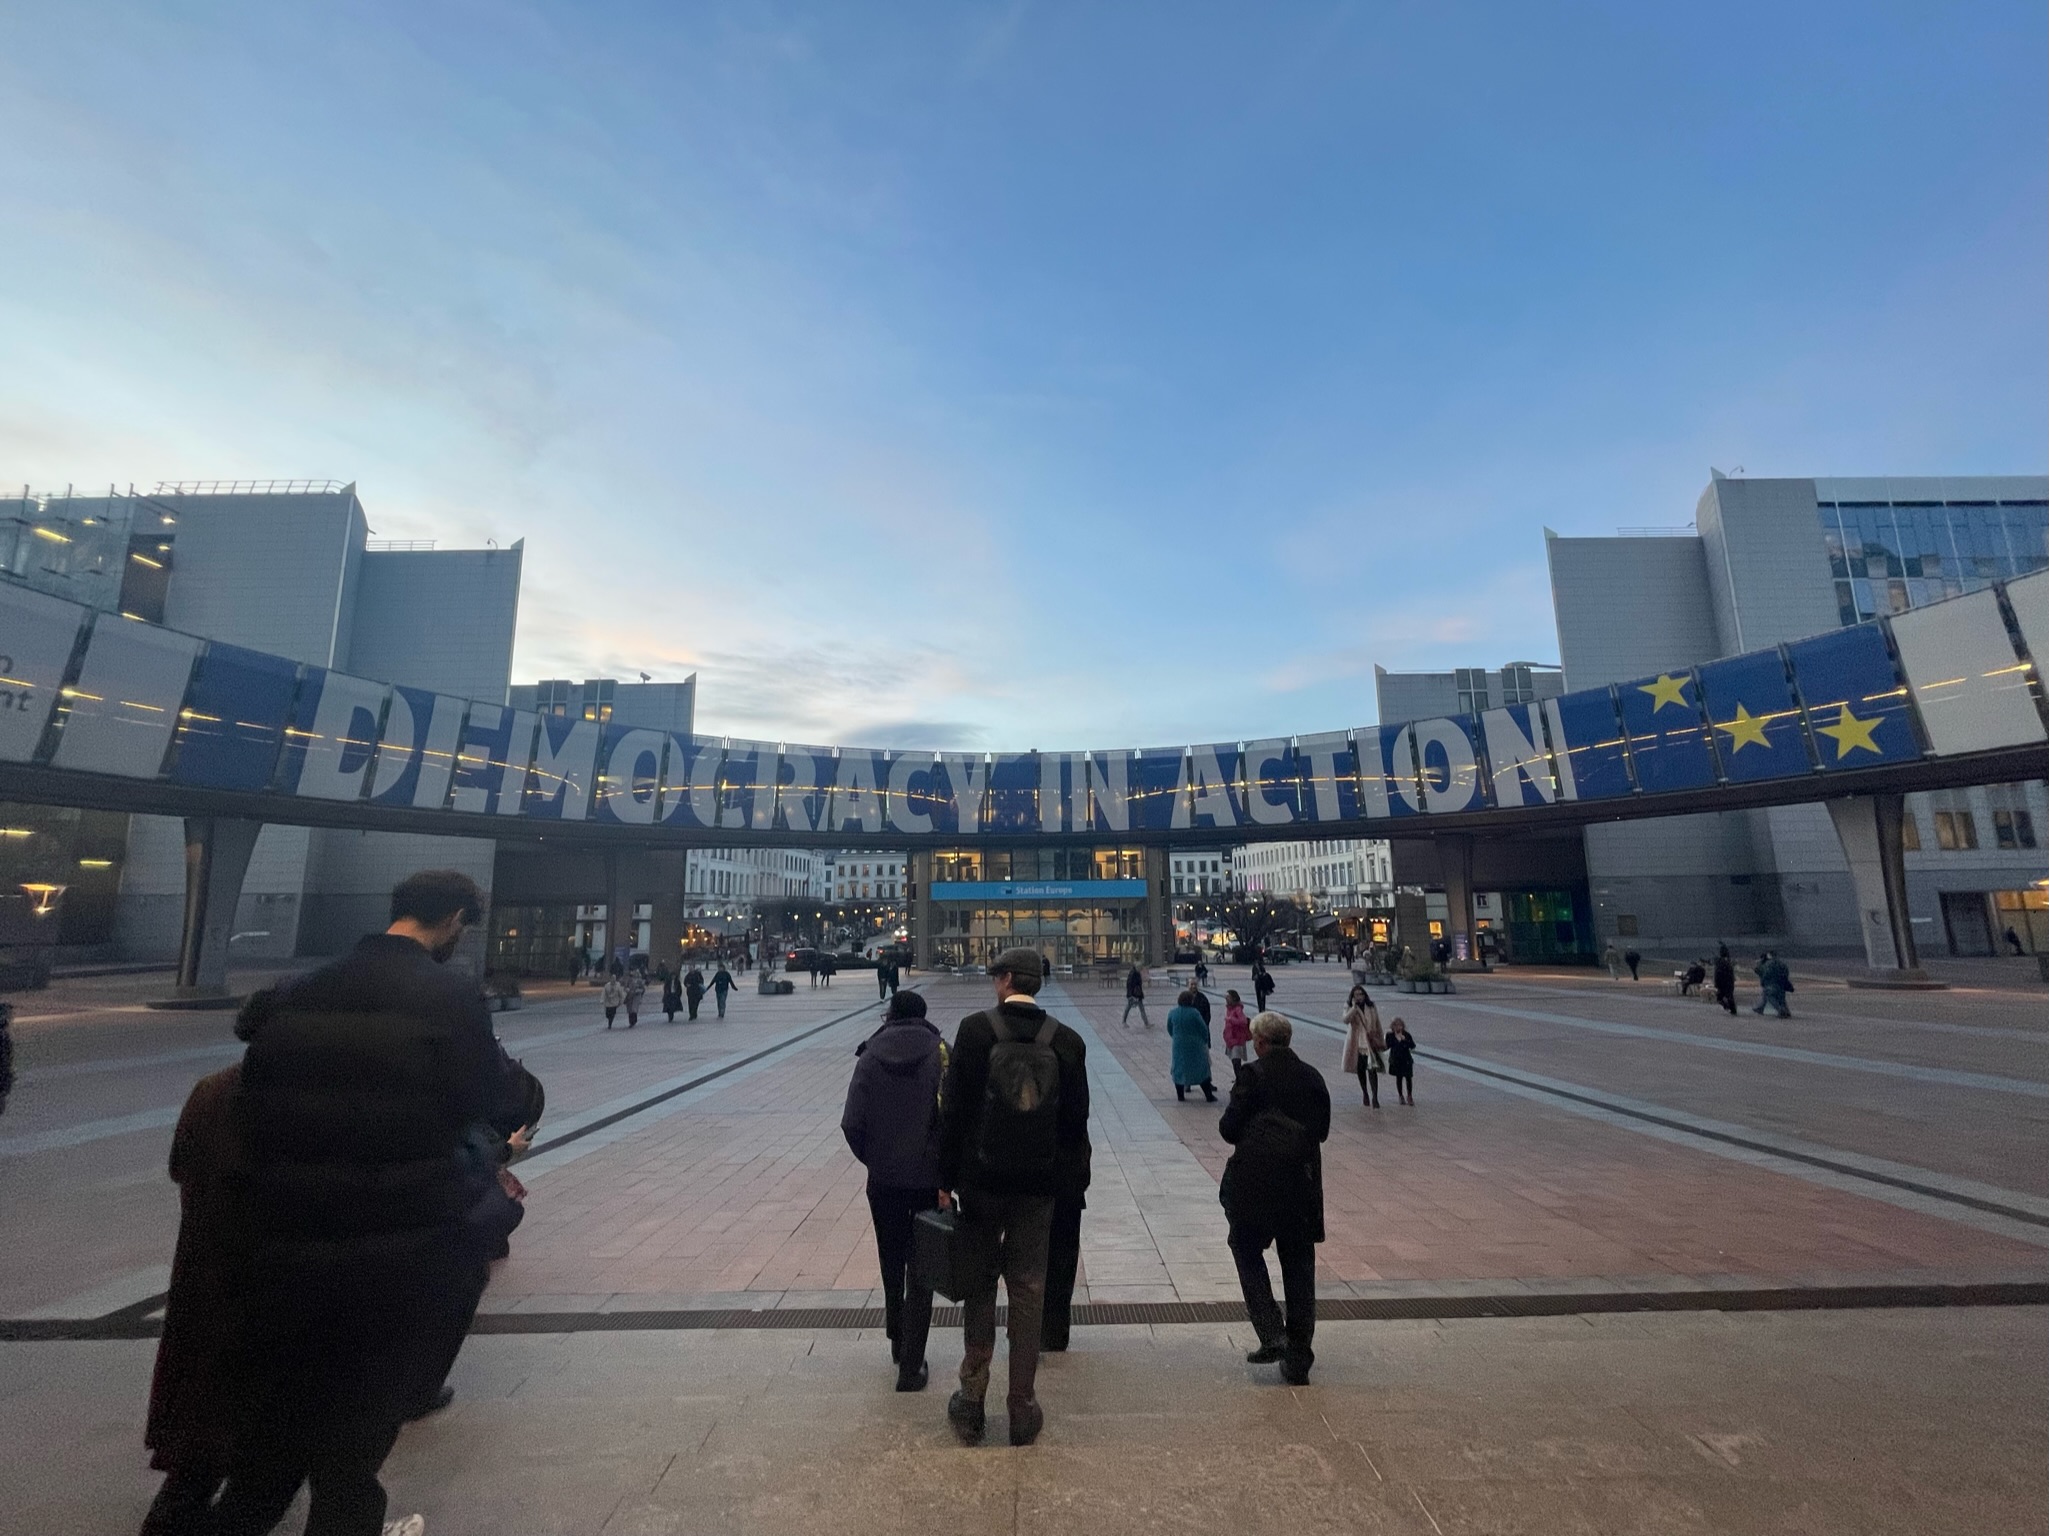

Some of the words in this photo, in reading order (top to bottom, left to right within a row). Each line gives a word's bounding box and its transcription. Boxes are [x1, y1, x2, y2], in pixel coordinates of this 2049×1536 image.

[296, 671, 1000, 834] DEMOCRACY
[1040, 753, 1129, 832] IN
[1170, 699, 1578, 829] ACTION
[1015, 886, 1044, 895] Station
[1045, 885, 1073, 896] Europe
